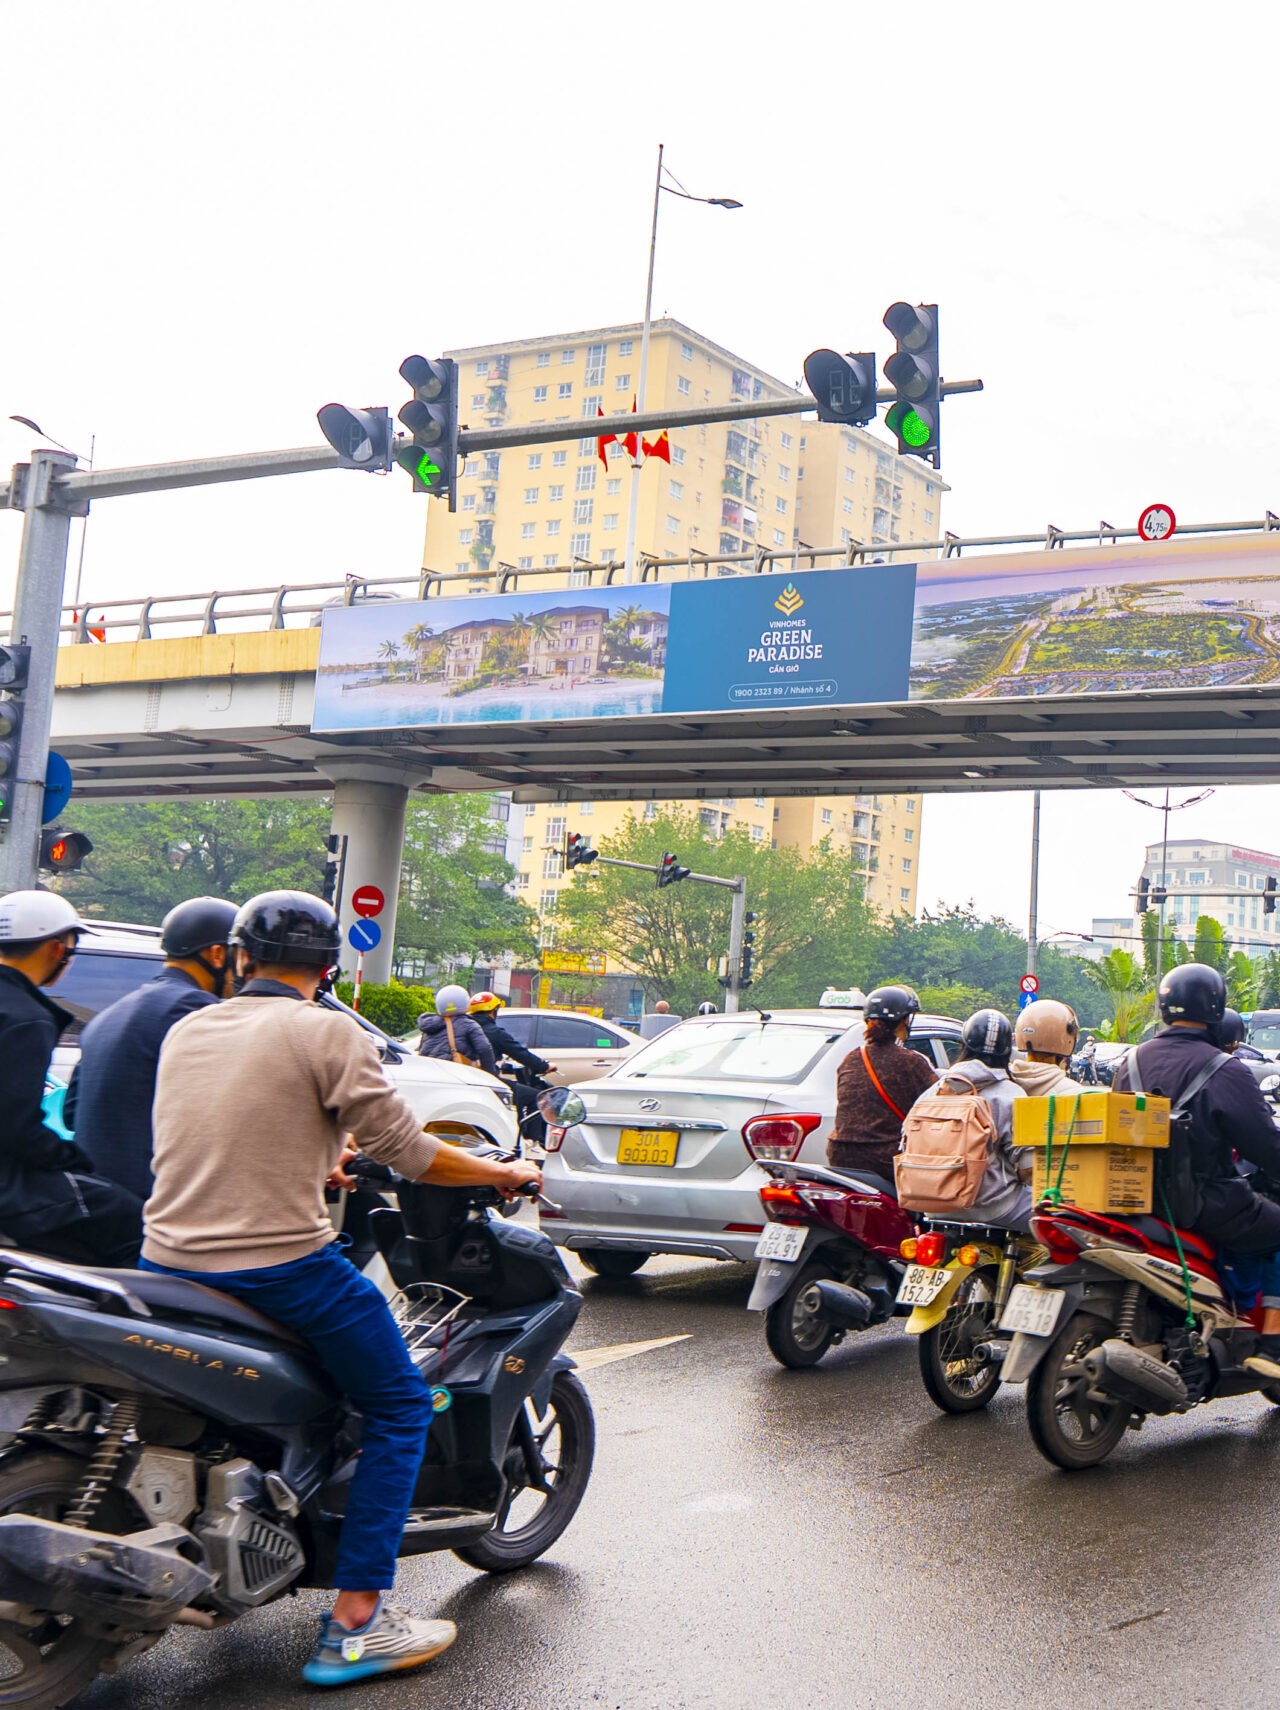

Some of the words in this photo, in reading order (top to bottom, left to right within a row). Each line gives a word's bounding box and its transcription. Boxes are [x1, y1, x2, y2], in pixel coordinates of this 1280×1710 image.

[769, 619, 806, 629] VINHOMES
[760, 629, 812, 646] GREEN
[747, 644, 823, 663] PARADISE
[734, 688, 753, 697] 1900
[753, 687, 772, 696] 2323
[773, 687, 783, 695] 89
[790, 686, 814, 695] Nhánh
[825, 684, 831, 692] 4
[827, 994, 852, 1004] Grab
[636, 1133, 660, 1147] 30A
[623, 1147, 669, 1164] 903.03
